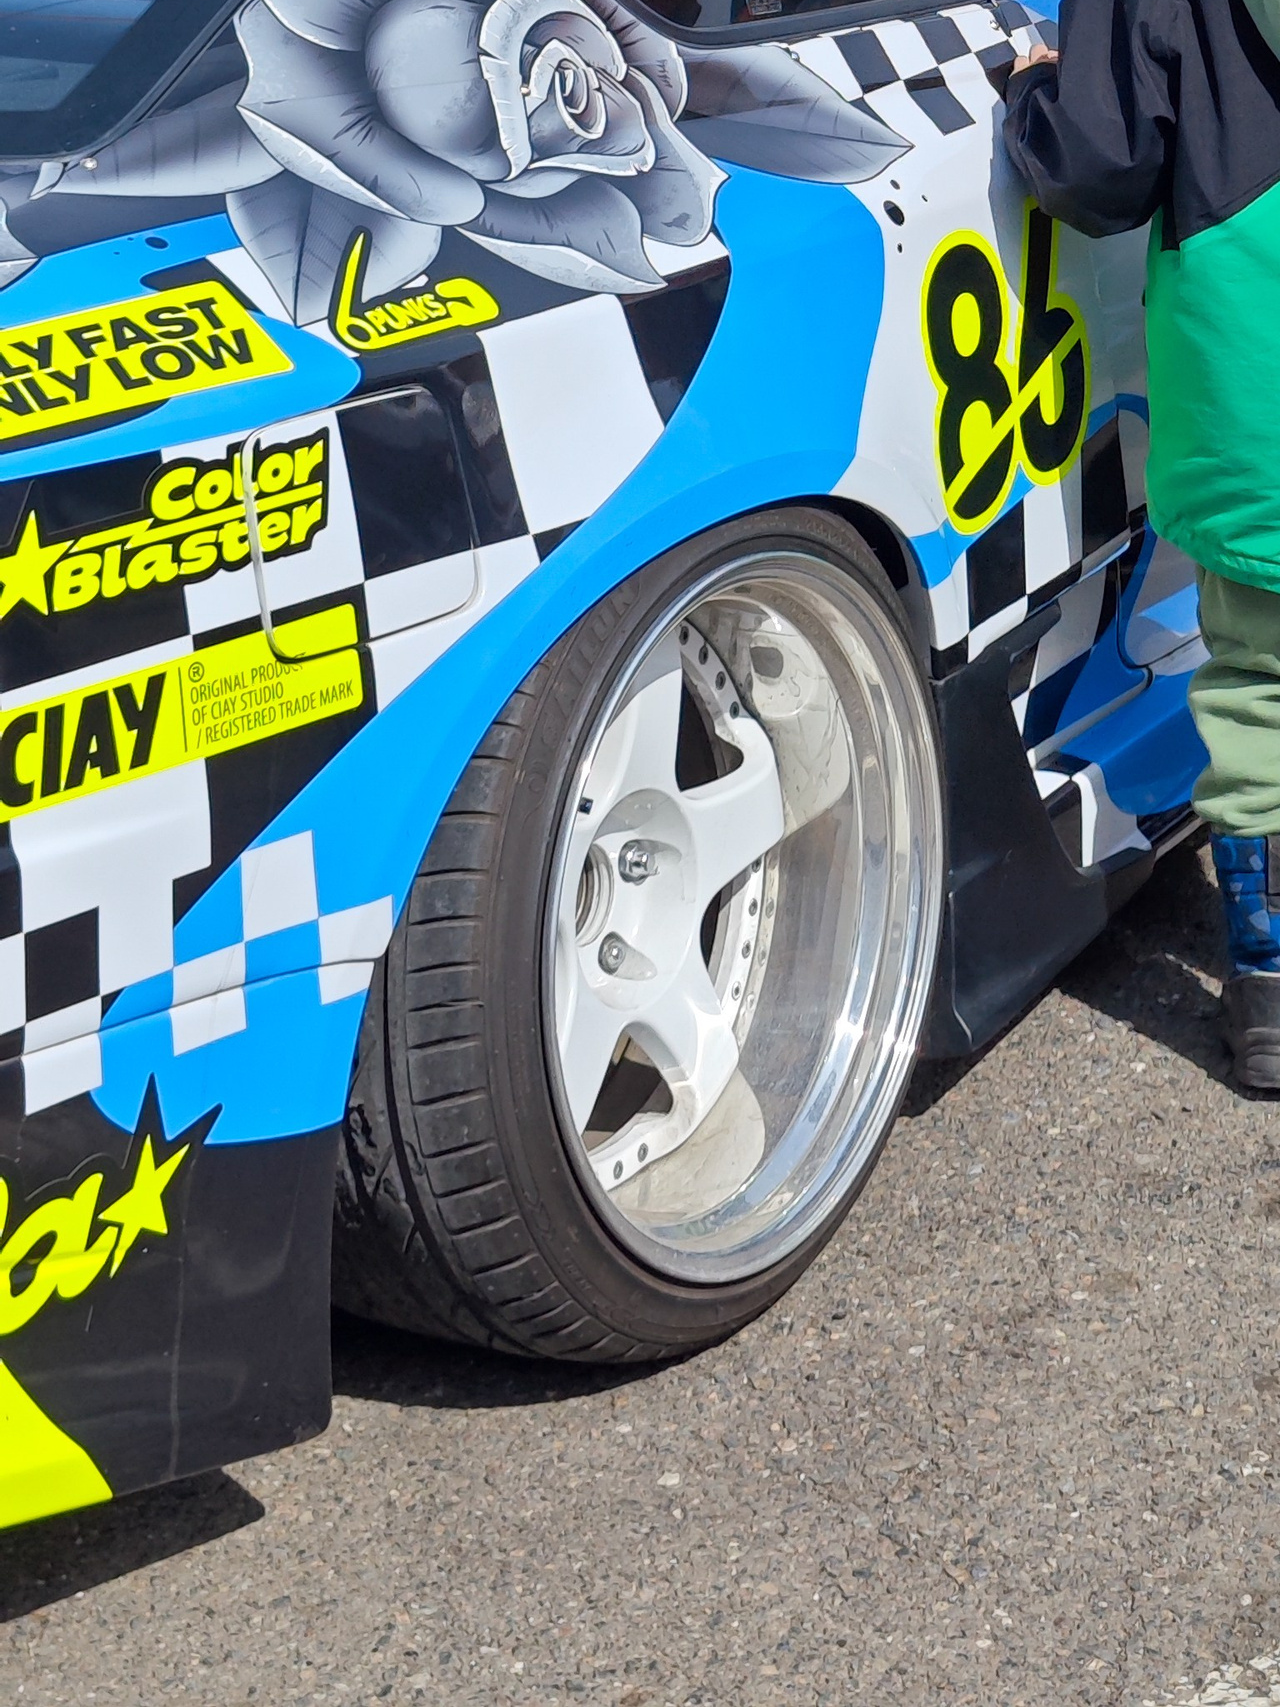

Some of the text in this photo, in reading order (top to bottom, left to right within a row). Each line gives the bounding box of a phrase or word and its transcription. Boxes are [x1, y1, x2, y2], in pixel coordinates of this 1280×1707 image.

[64, 297, 226, 359] FAST
[363, 293, 448, 334] PUNKS
[104, 328, 255, 391] LOW
[926, 206, 1086, 521] 86
[52, 498, 323, 612] Blaster
[192, 705, 208, 726] OF
[240, 681, 284, 712] STUDIO
[205, 706, 277, 745] REGISTERED
[278, 691, 317, 720] TRADE
[319, 679, 354, 707] MARK
